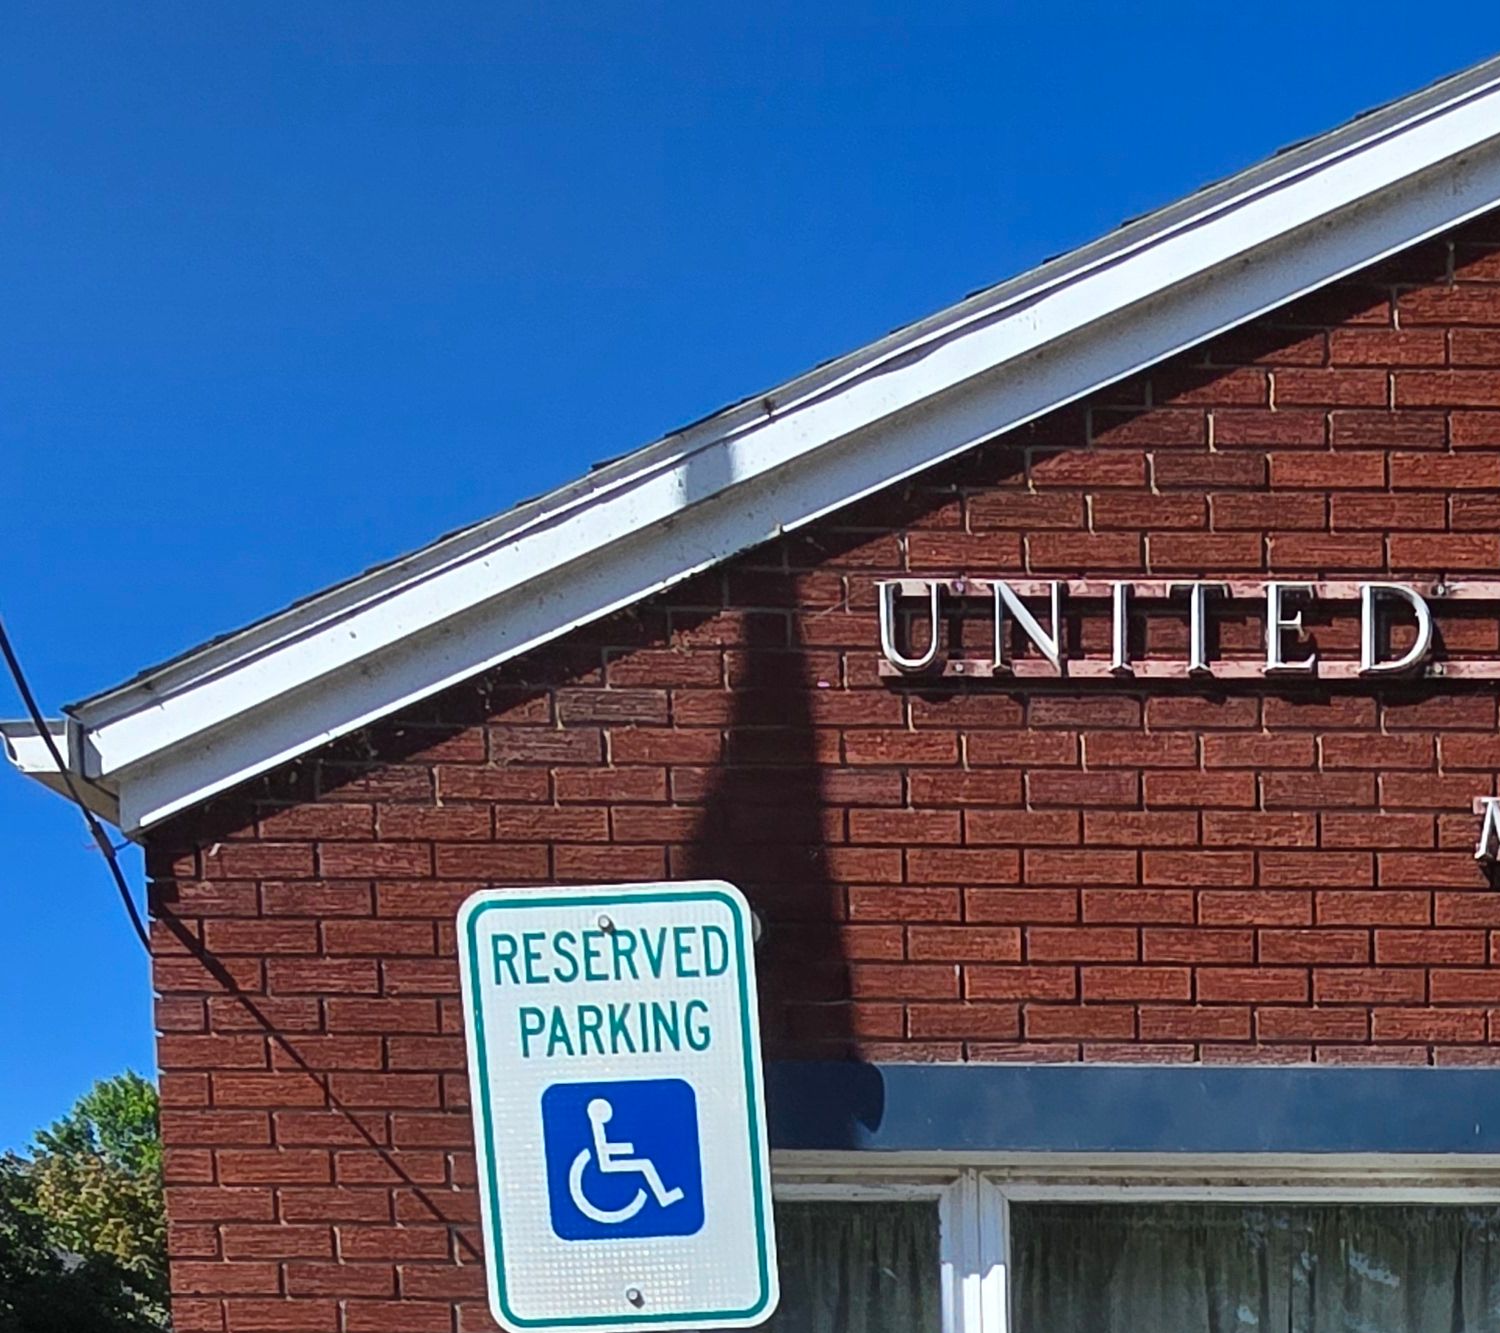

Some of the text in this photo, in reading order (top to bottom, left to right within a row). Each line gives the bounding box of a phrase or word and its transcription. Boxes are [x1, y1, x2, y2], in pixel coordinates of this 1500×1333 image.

[876, 580, 1434, 674] UNITED
[491, 924, 729, 985] RESERVED
[519, 1000, 711, 1057] PARKING
